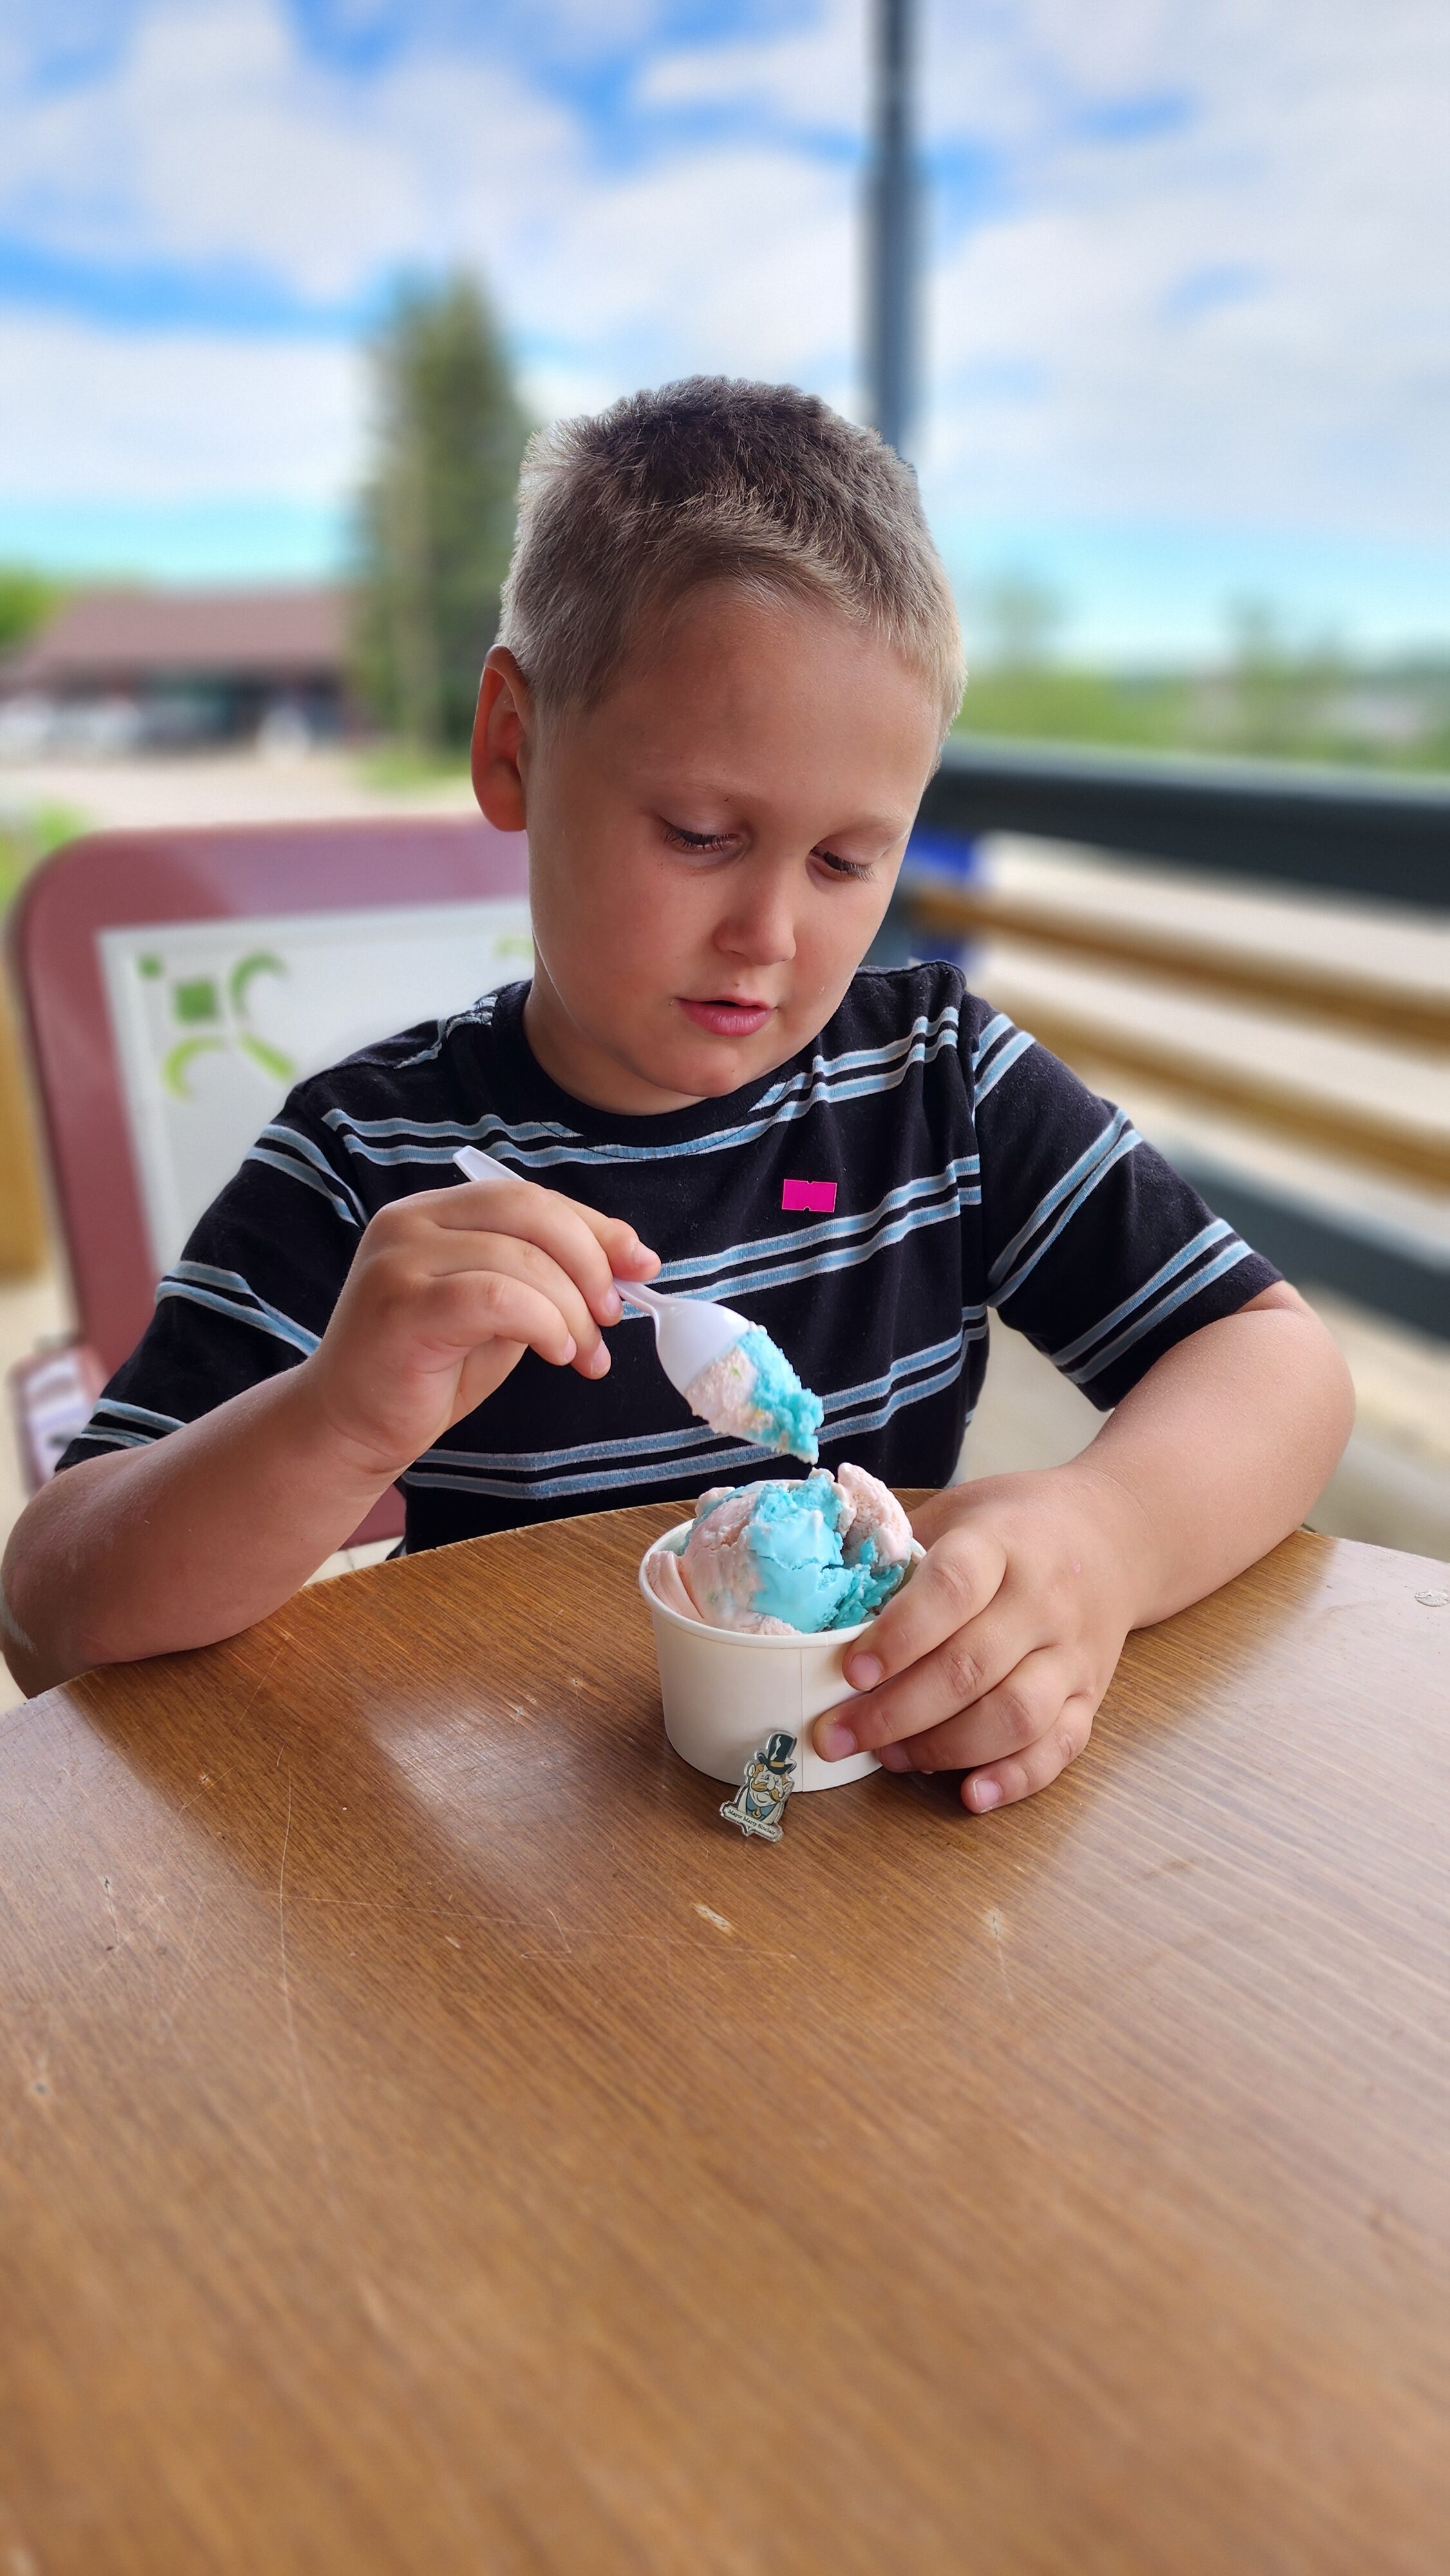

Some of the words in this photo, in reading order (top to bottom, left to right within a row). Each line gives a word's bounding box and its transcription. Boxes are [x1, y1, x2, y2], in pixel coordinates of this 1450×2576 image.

[728, 1809, 743, 1819] Mayor
[743, 1816, 757, 1826] Marty
[758, 1824, 776, 1835] Sinclair
